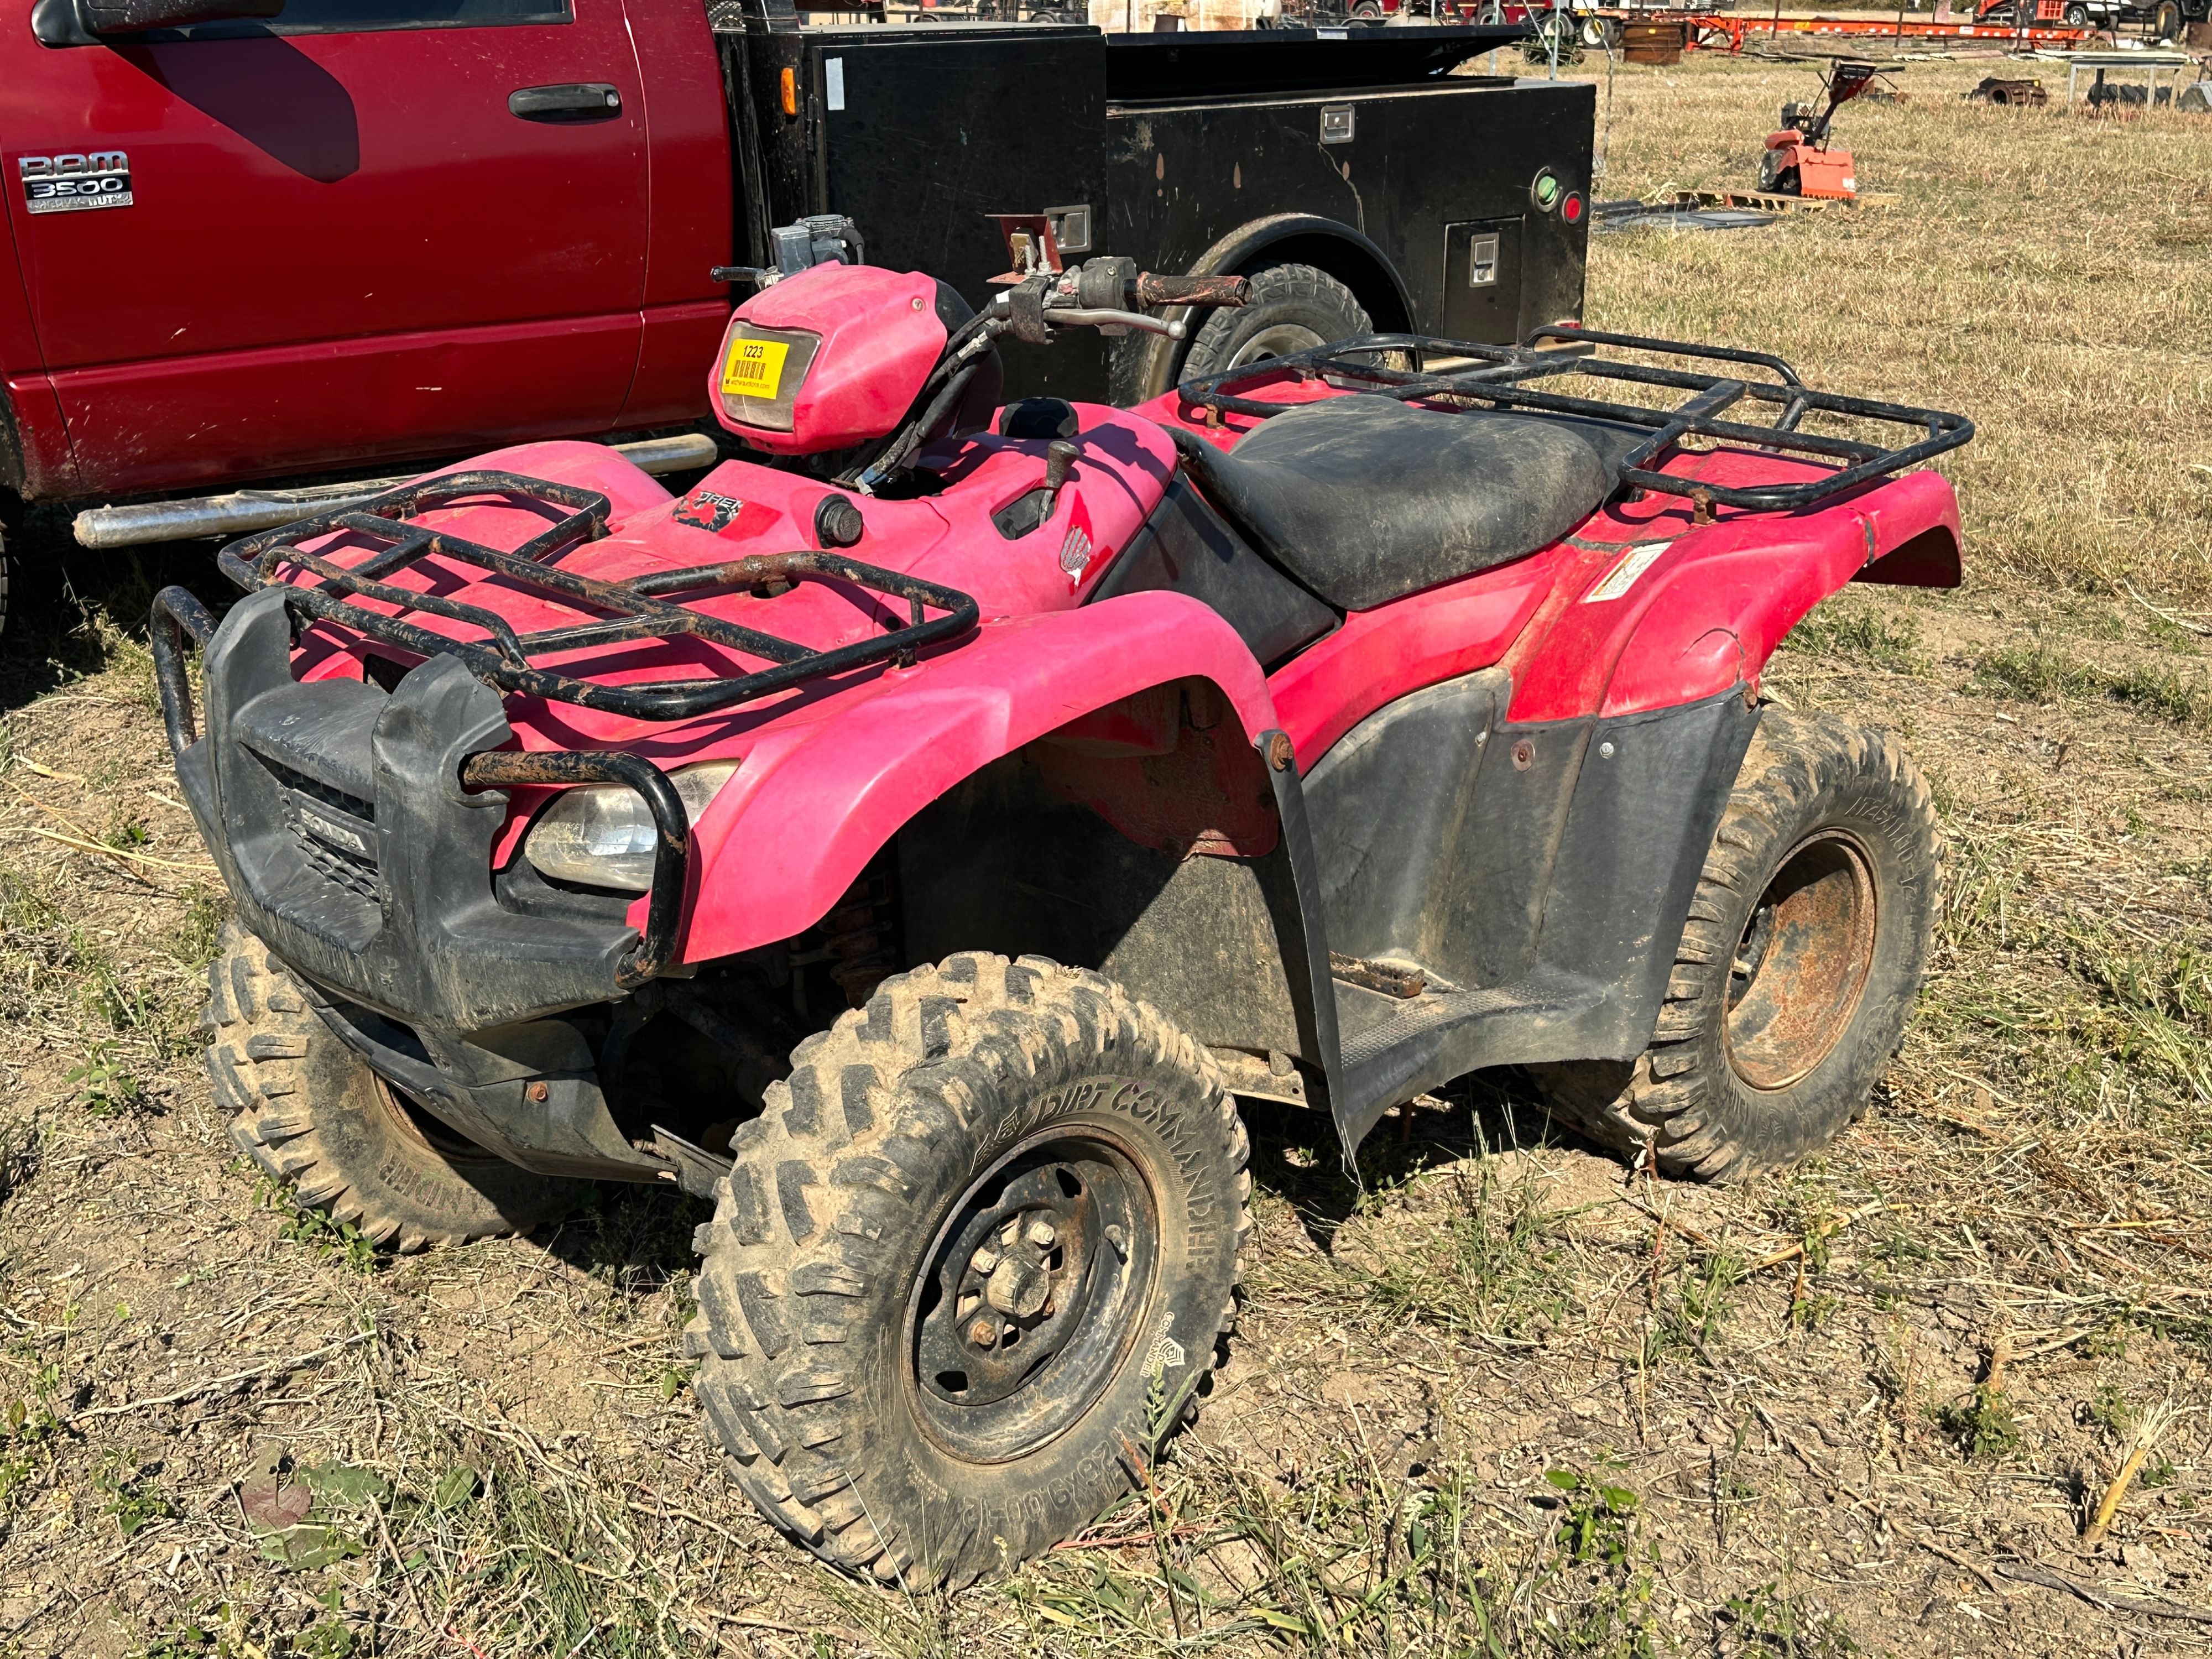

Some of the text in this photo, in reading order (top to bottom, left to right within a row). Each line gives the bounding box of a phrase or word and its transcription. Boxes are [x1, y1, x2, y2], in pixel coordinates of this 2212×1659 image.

[18, 151, 129, 180] RAM
[31, 178, 123, 198] 3500
[743, 345, 764, 358] 1223
[1033, 1082, 1112, 1121] DIRT
[1140, 1311, 1175, 1378] COMMANDER
